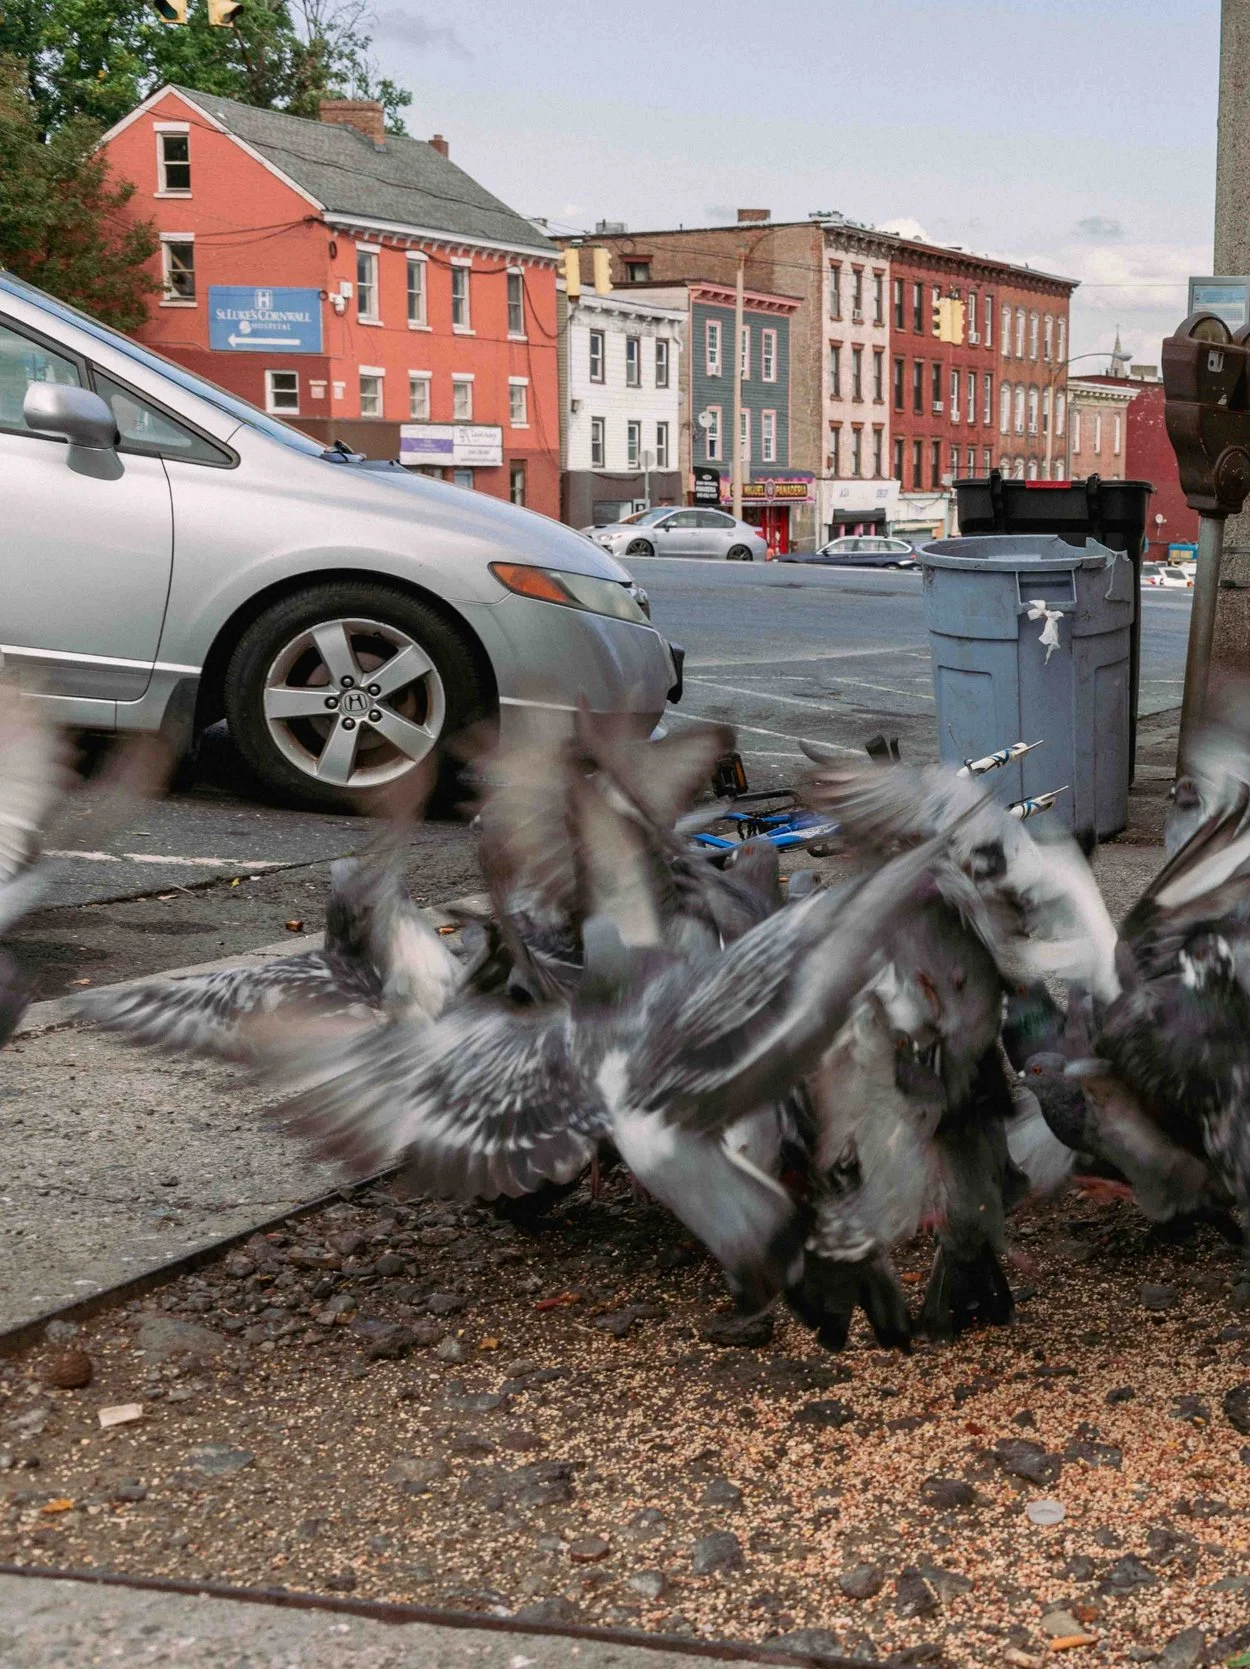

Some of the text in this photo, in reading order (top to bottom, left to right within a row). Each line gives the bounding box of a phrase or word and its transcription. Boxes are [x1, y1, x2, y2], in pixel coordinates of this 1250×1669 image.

[258, 310, 312, 322] CORNWALL
[251, 322, 291, 331] HOSPITAL
[775, 485, 807, 497] PANADERIA
